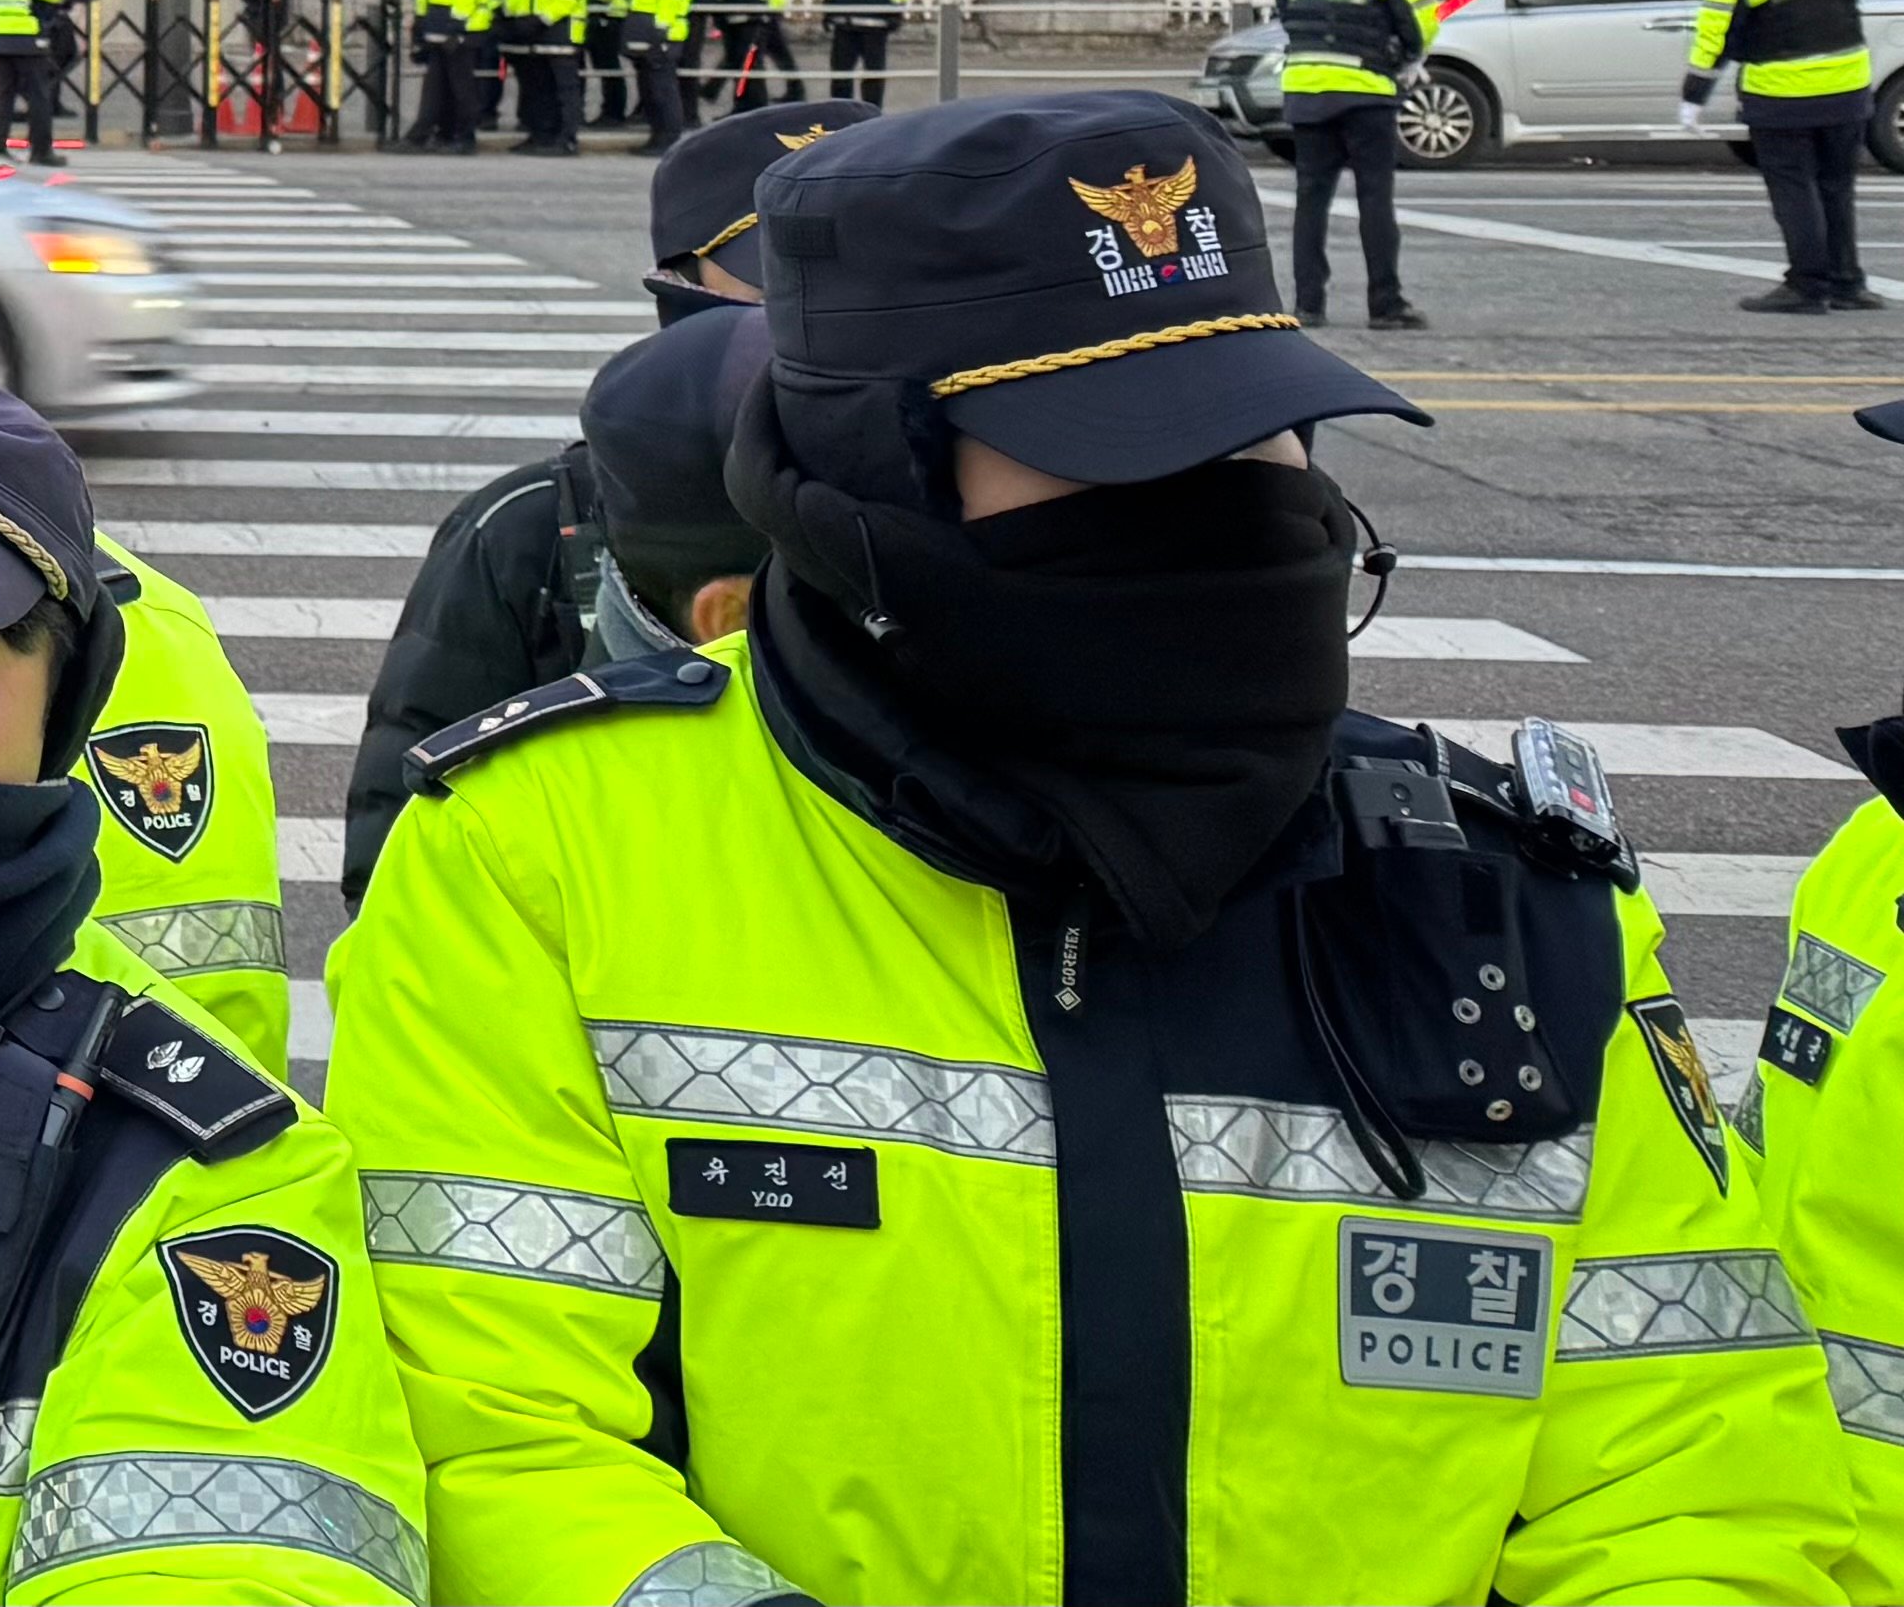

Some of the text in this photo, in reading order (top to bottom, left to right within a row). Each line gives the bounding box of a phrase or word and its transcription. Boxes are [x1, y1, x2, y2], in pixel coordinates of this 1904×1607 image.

[142, 813, 194, 831] POLICE
[752, 1190, 794, 1208] YOO
[1362, 1241, 1528, 1326] 경찰
[220, 1345, 292, 1380] POLICE
[1359, 1332, 1521, 1375] POLICE
